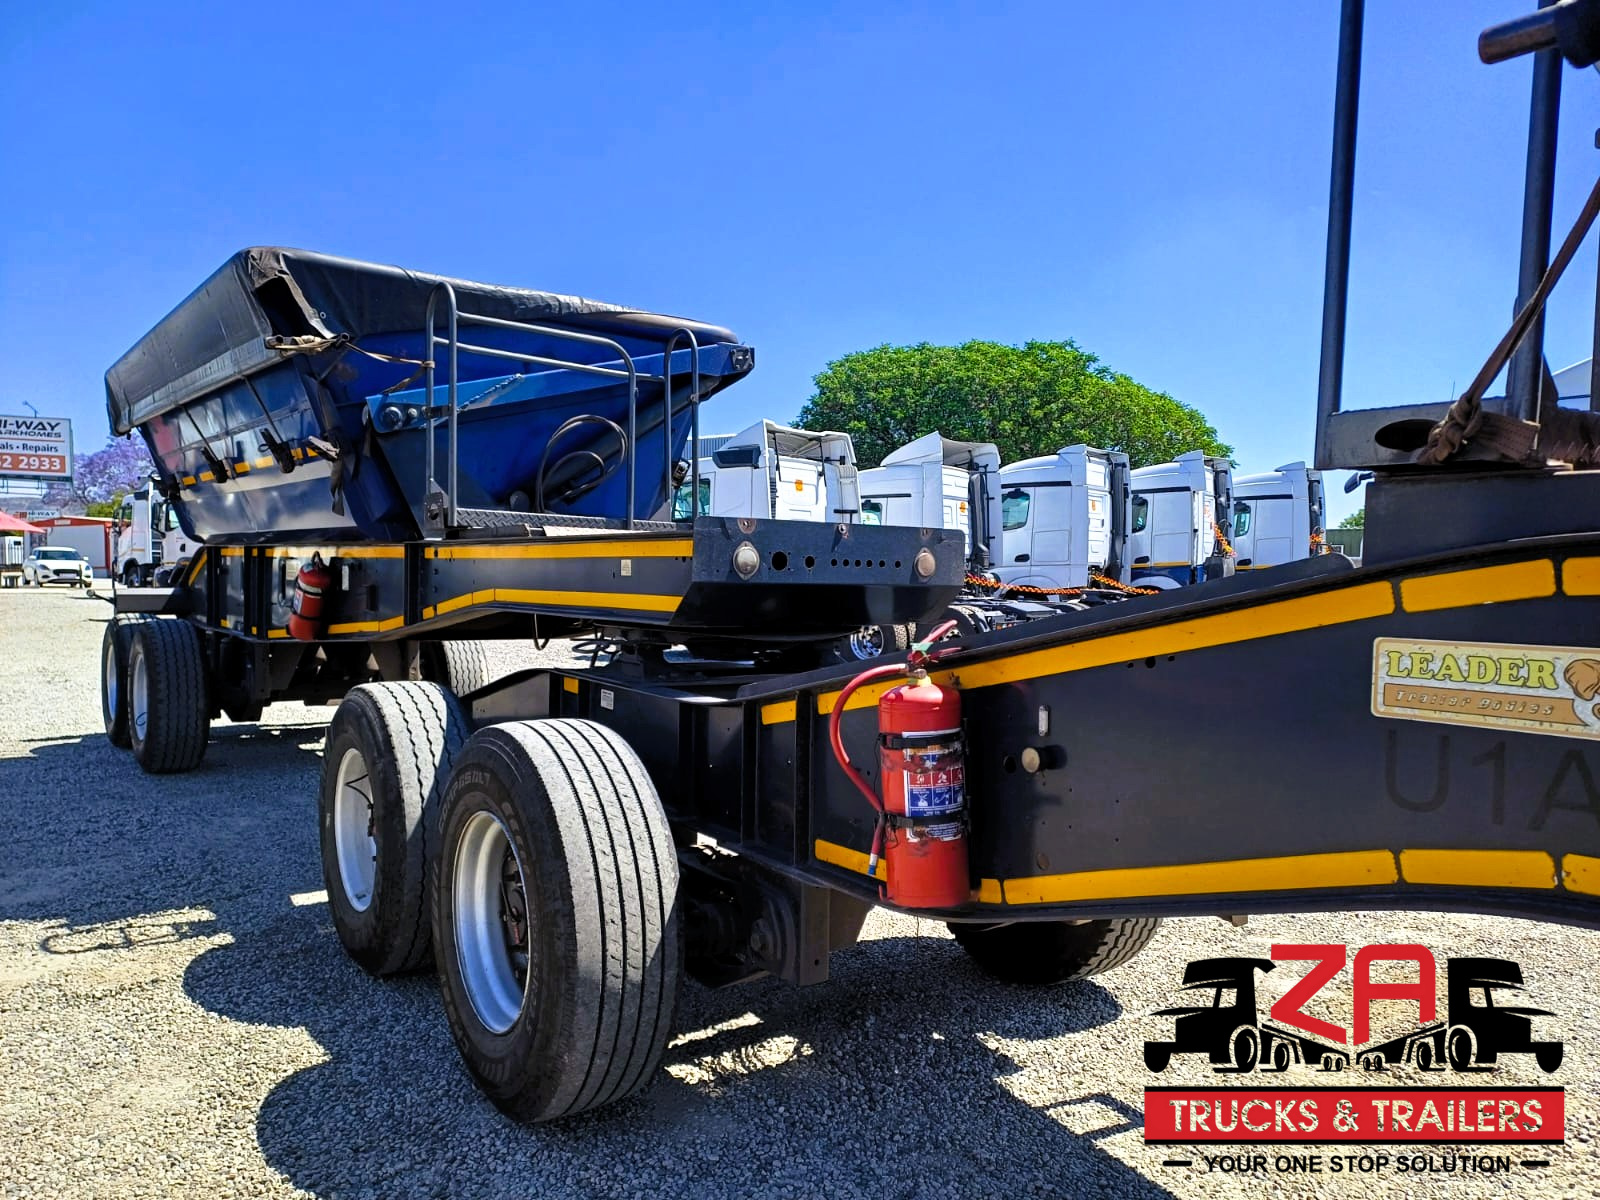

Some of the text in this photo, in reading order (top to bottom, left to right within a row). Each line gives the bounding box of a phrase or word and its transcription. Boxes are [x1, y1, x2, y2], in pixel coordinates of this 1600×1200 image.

[22, 443, 58, 453] Repairs
[0, 455, 61, 470] 2 2933
[1386, 651, 1558, 690] LEADER
